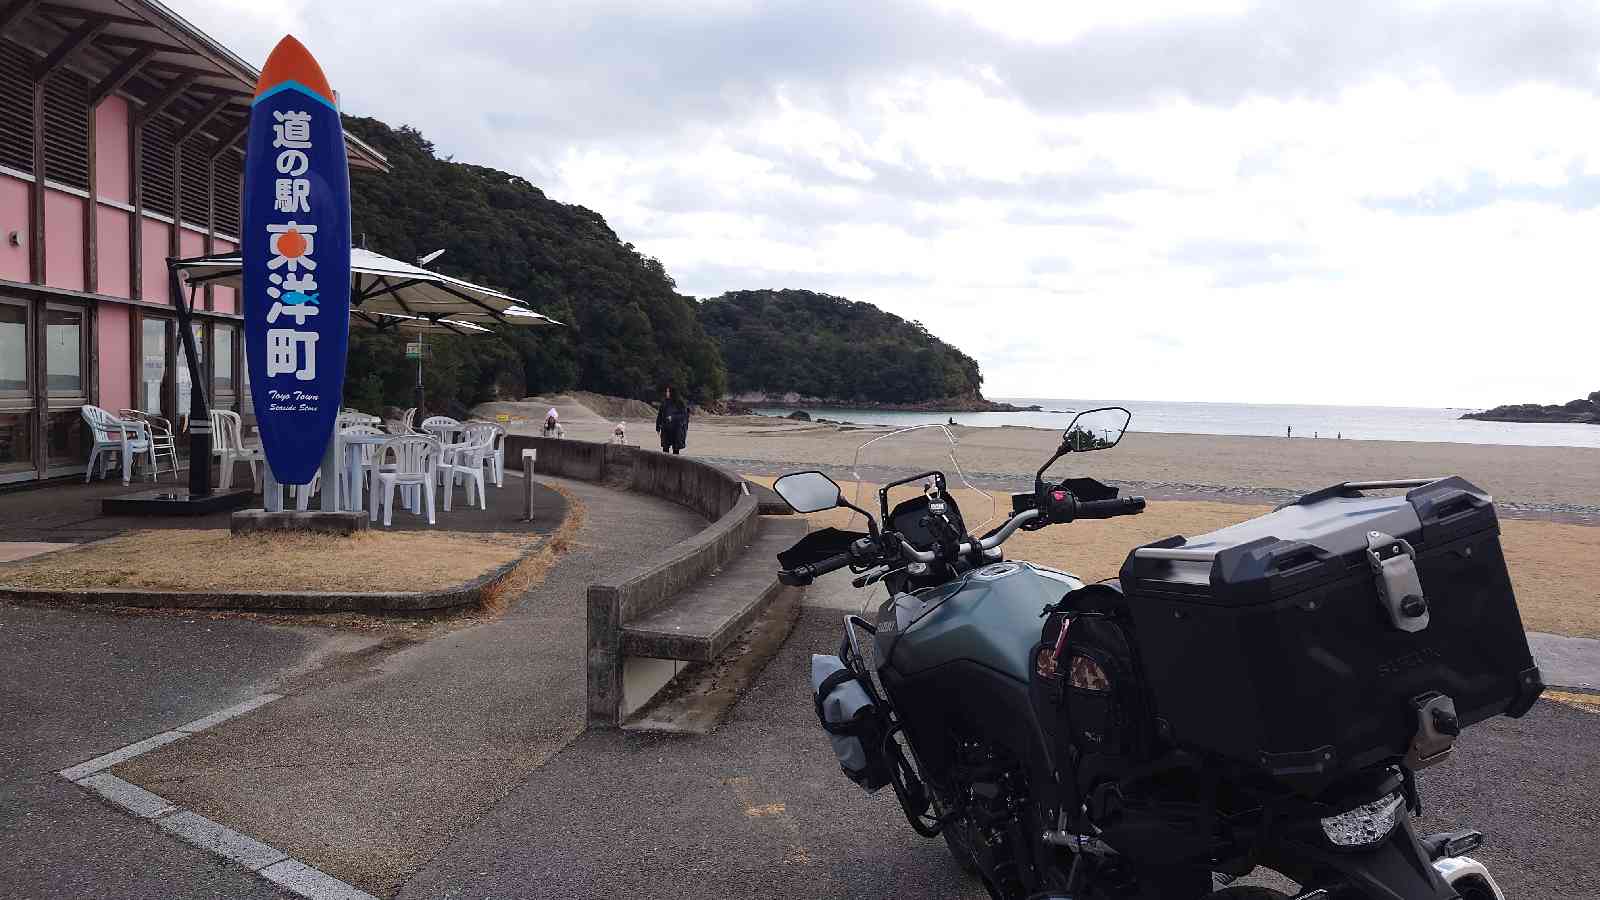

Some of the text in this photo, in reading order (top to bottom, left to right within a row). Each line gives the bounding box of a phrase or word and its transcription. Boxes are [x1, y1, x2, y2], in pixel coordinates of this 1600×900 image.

[273, 110, 312, 212] 道の駅
[266, 220, 319, 380] 東洋町
[268, 390, 319, 401] Toyo Town
